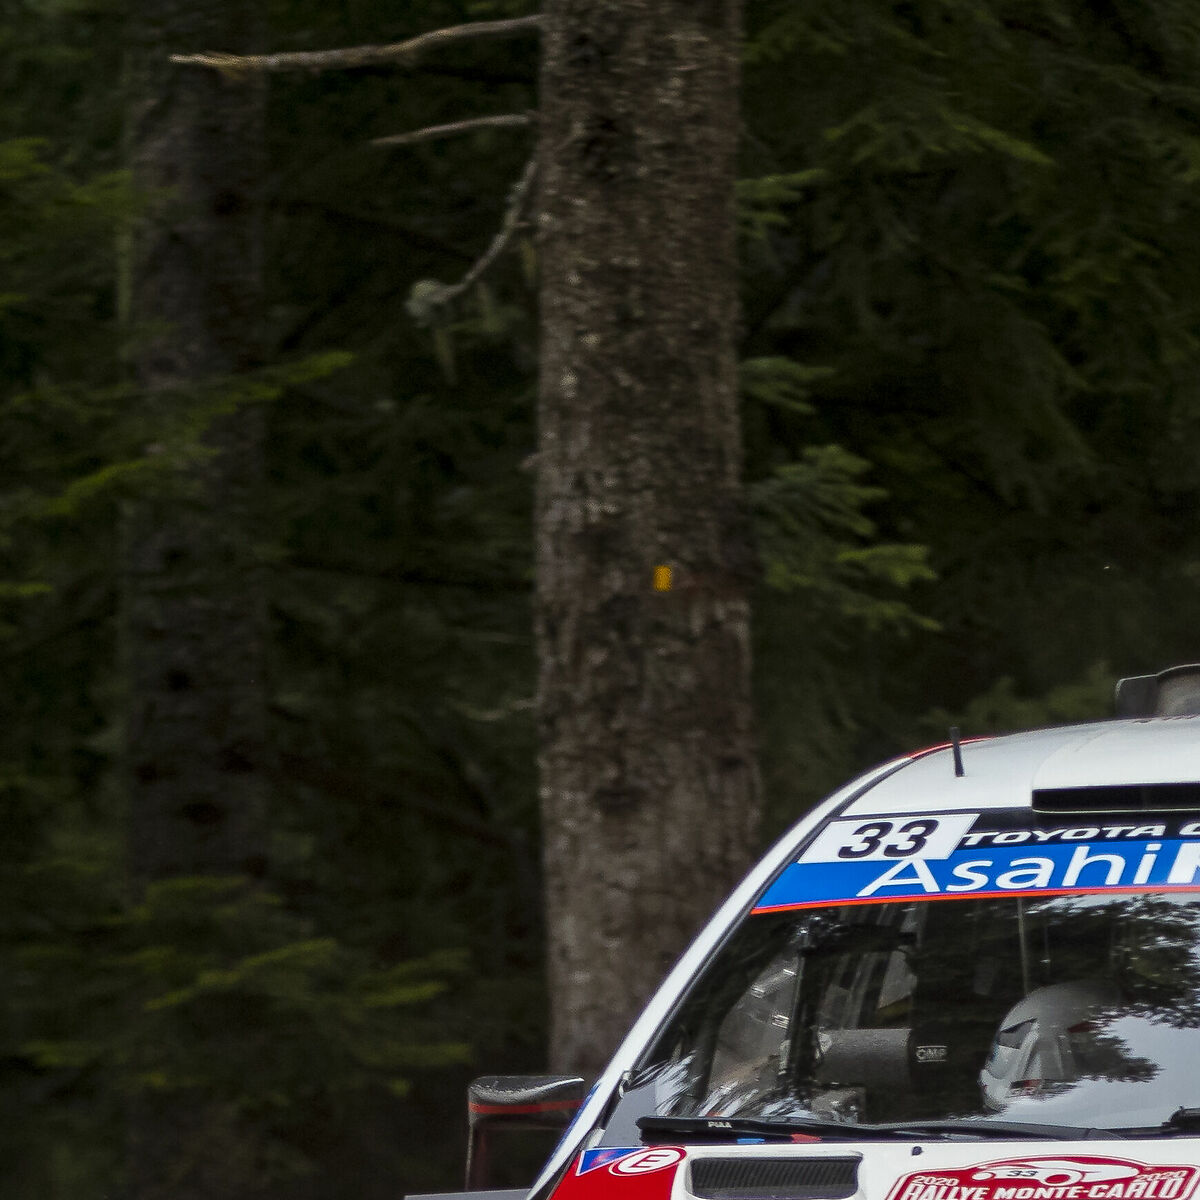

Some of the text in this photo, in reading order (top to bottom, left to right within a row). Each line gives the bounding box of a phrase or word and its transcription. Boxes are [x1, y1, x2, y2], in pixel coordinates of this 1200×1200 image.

[838, 819, 940, 859] 33
[962, 825, 1166, 846] TOYOTA
[1005, 1168, 1038, 1177] 33
[1135, 1170, 1188, 1182] 2020
[911, 1175, 960, 1187] 2020
[992, 1179, 1184, 1200] MONTE-CARLO
